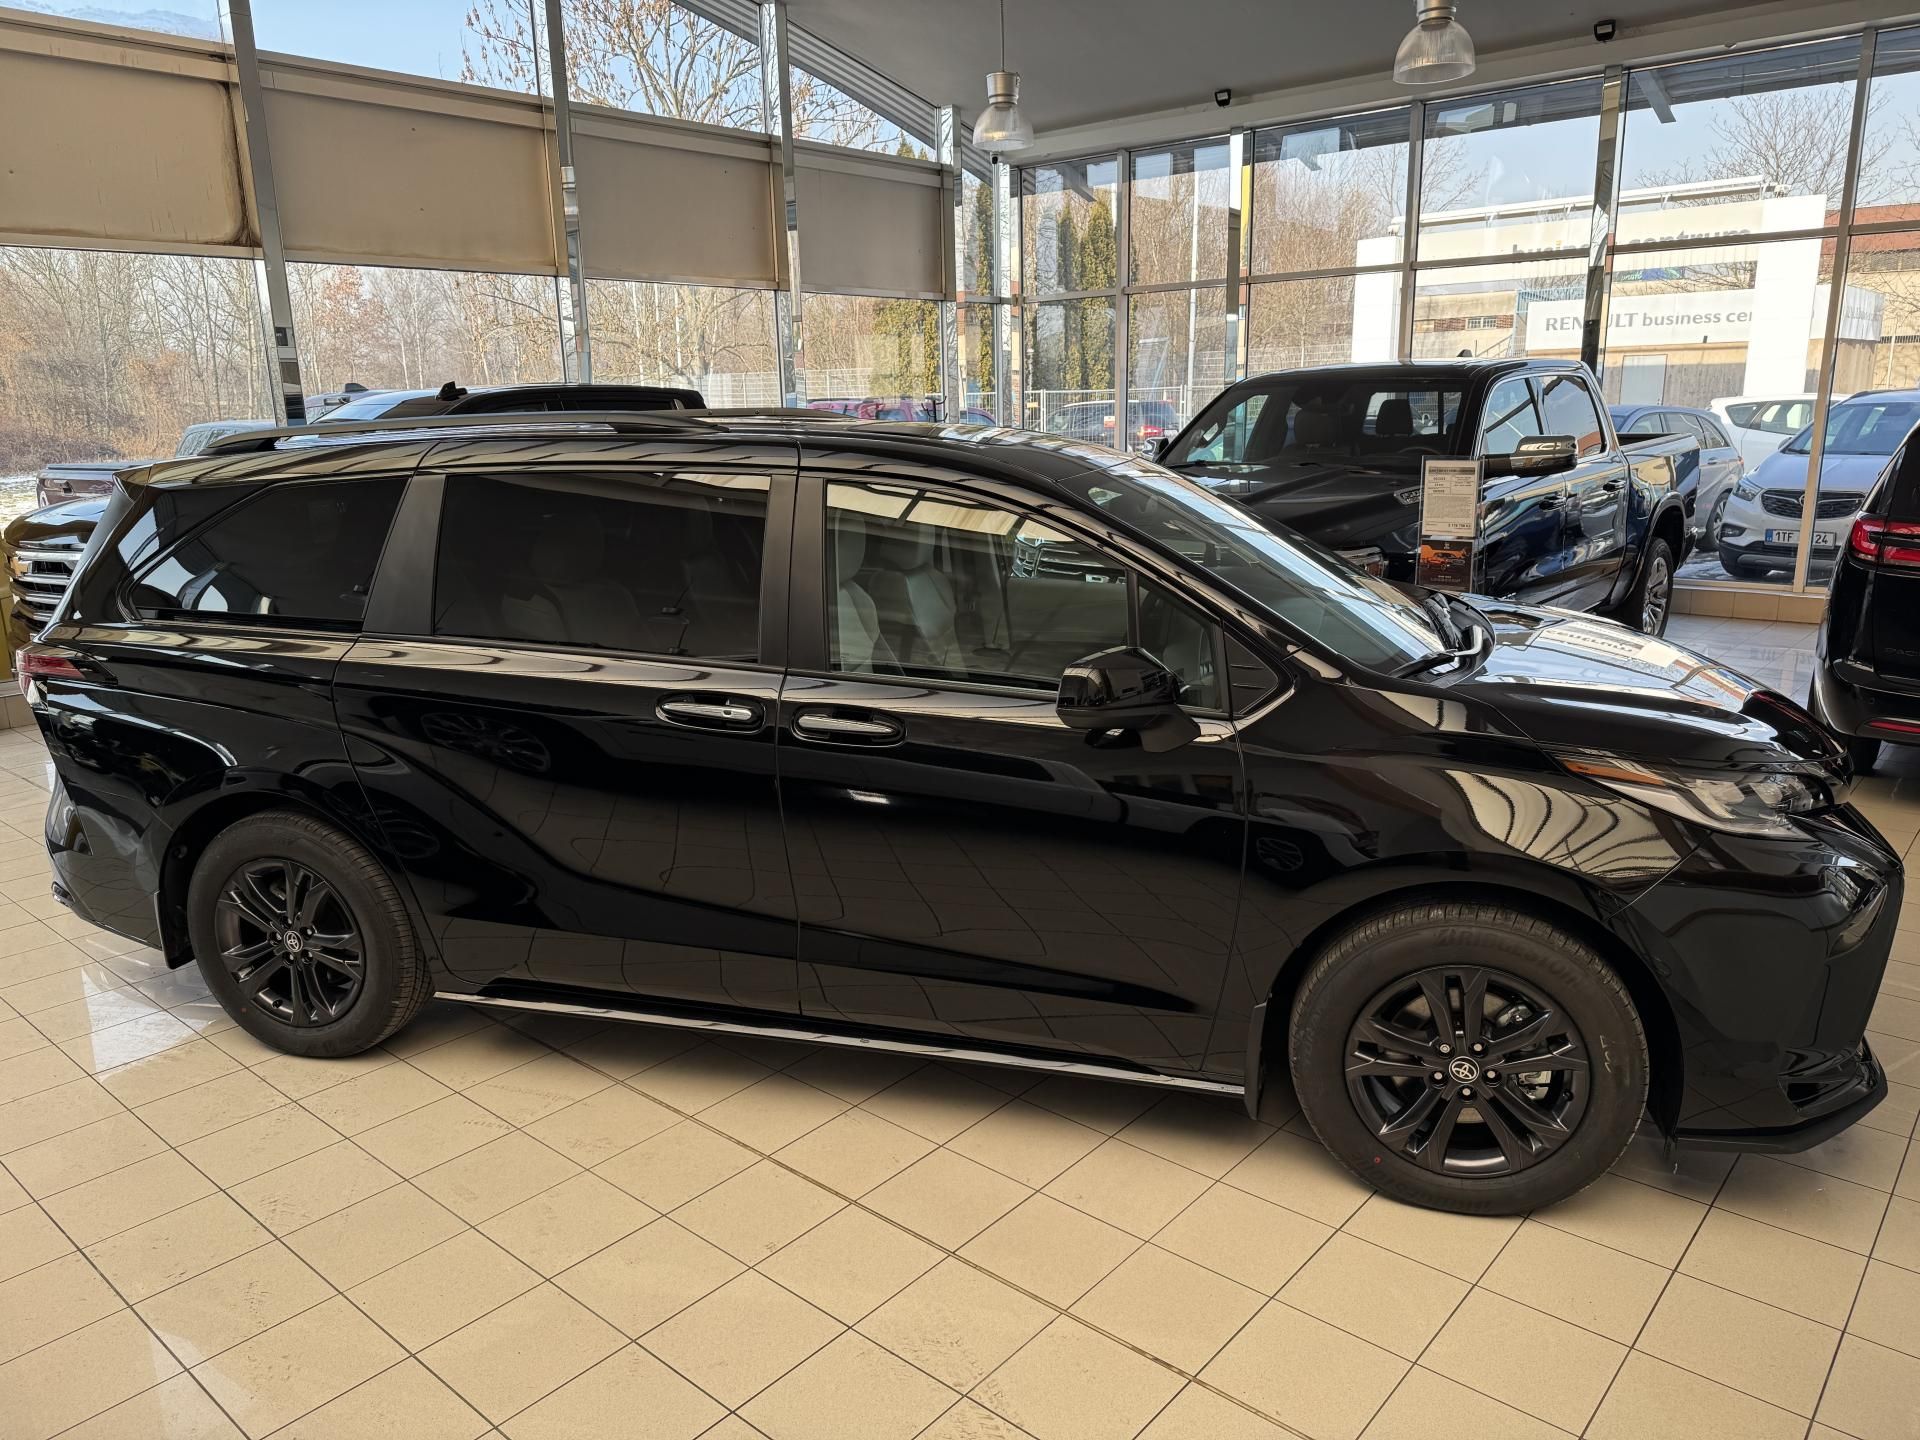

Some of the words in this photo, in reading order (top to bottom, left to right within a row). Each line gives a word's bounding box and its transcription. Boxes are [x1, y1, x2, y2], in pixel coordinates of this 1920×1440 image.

[1642, 312, 1721, 326] business
[1775, 531, 1794, 542] 1TF
[1815, 534, 1828, 545] 24
